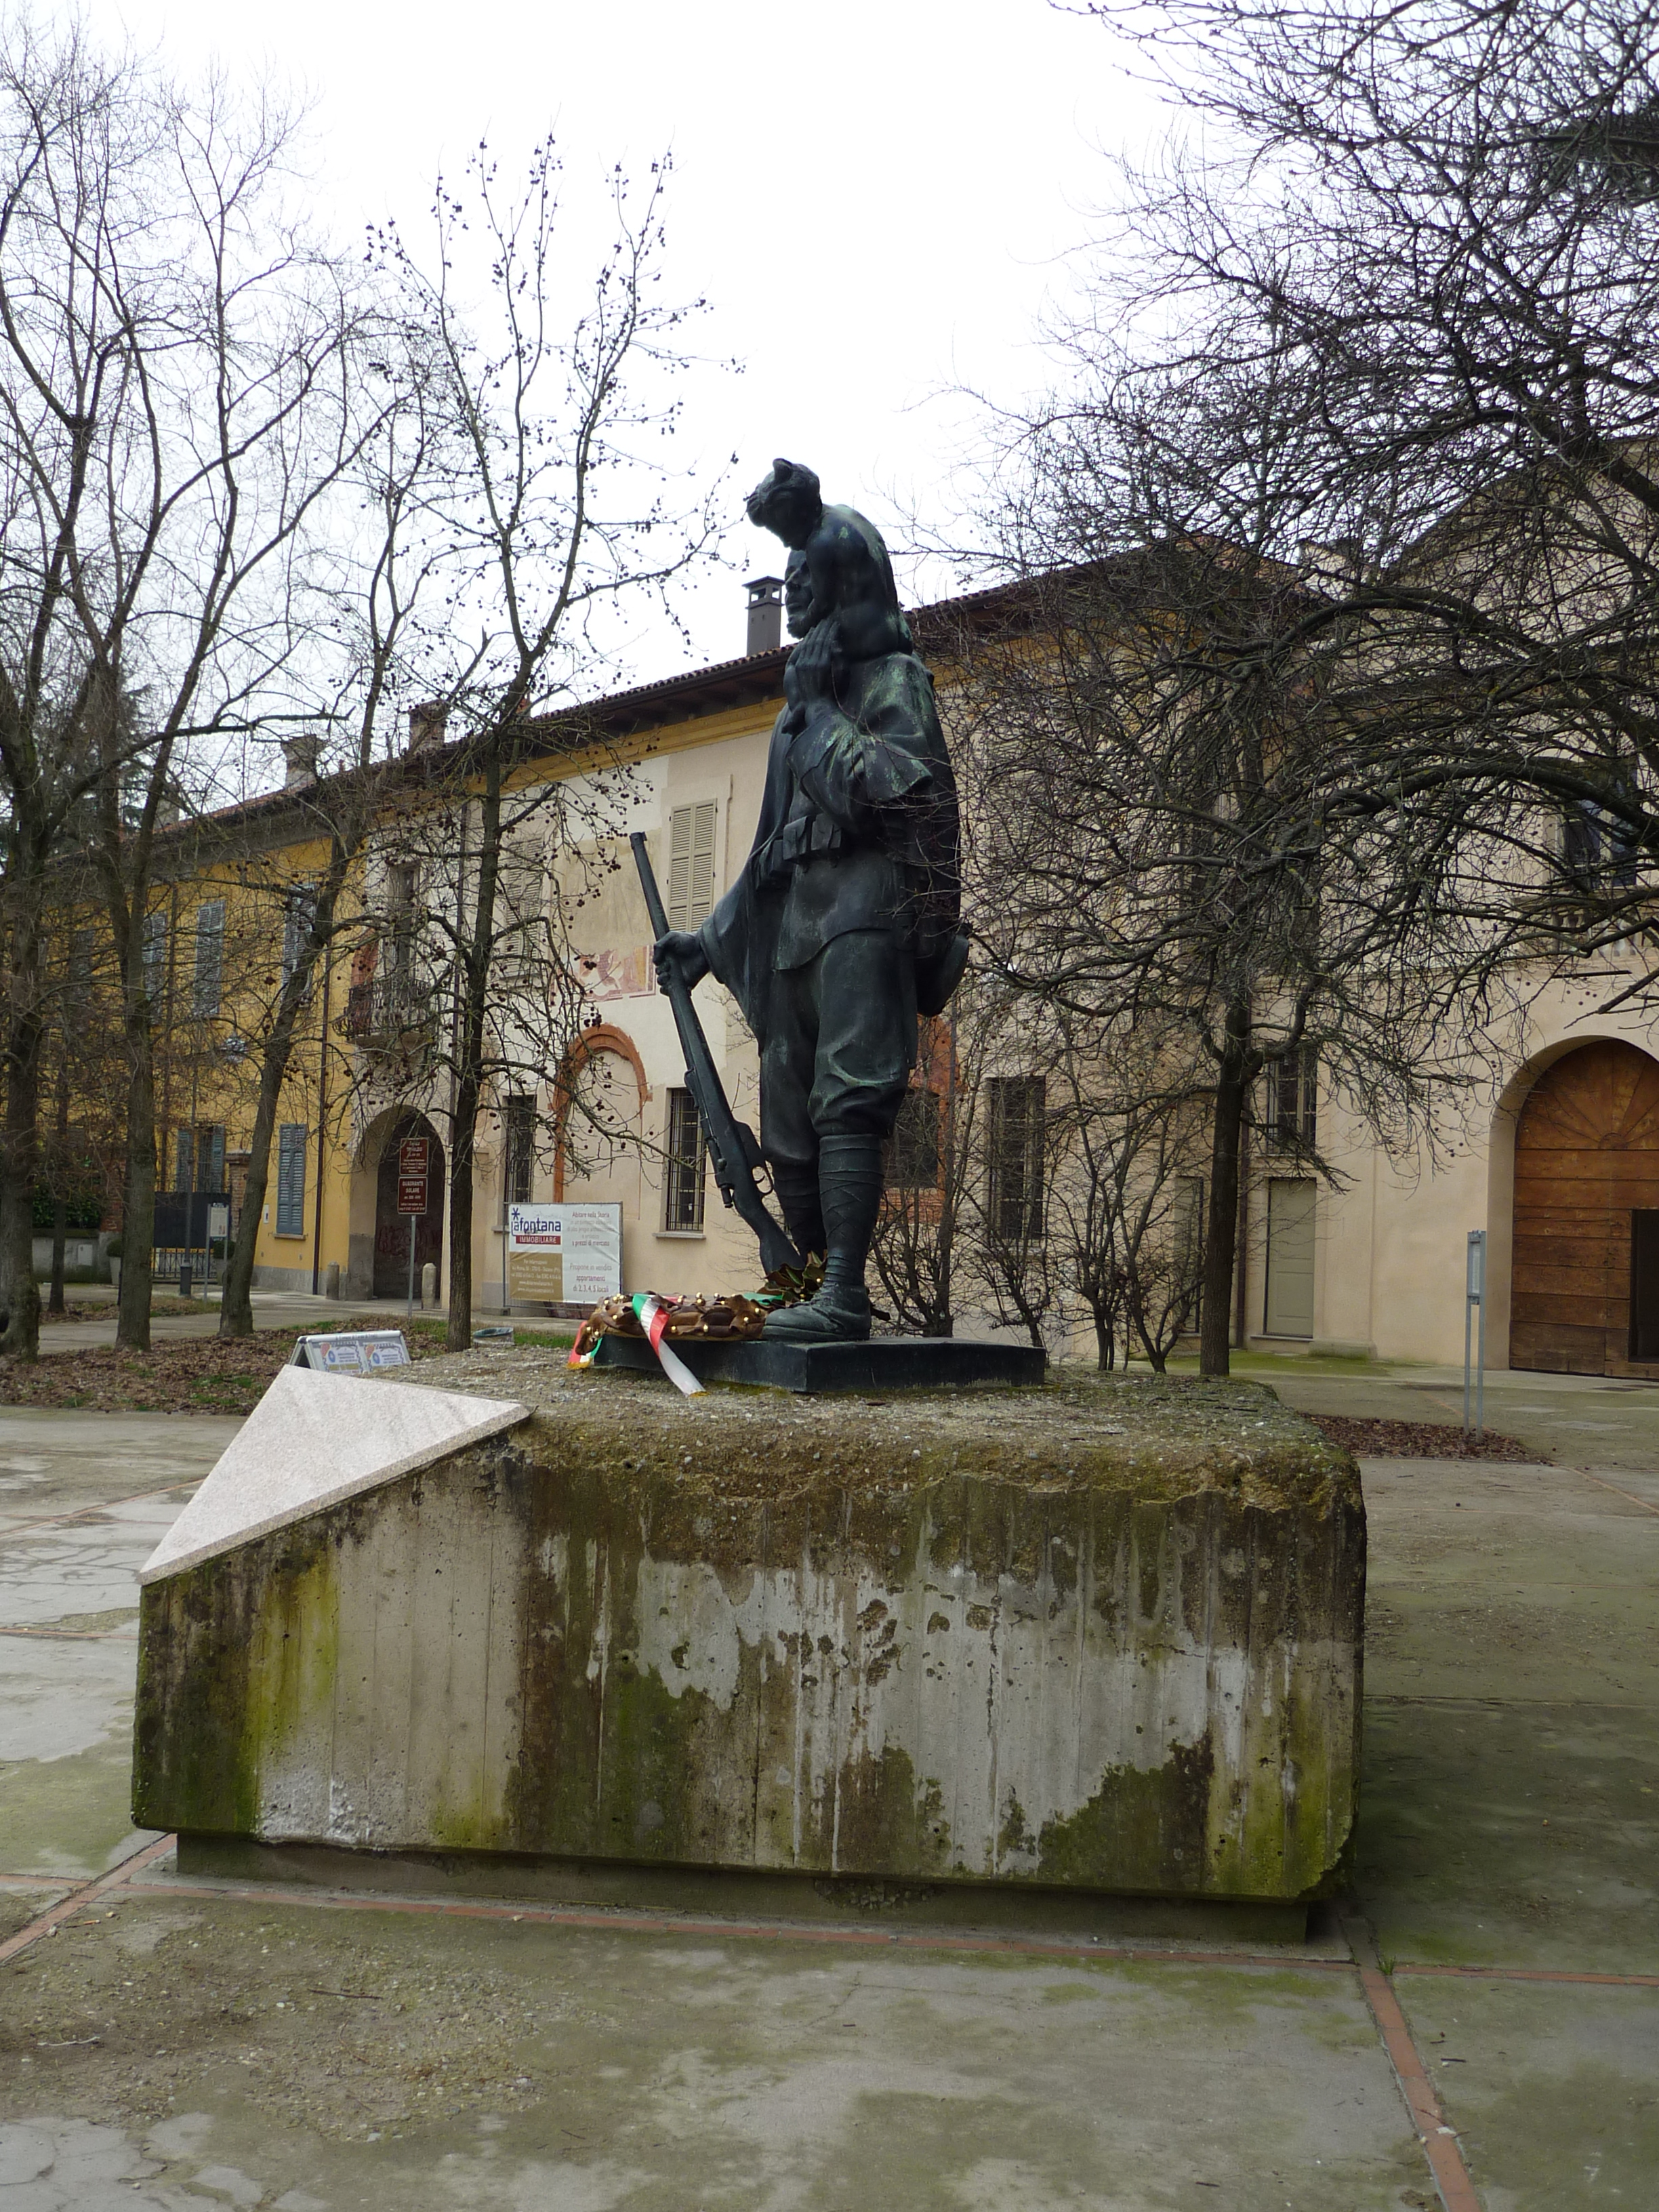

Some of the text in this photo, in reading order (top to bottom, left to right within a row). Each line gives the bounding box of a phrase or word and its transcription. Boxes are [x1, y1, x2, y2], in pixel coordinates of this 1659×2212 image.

[519, 1235, 557, 1244] IMMOBILIARE
[569, 1262, 590, 1272] Propone
[595, 1263, 613, 1271] vendita
[575, 1275, 606, 1283] appartamenti
[573, 1284, 578, 1292] di
[596, 1284, 609, 1292] locali
